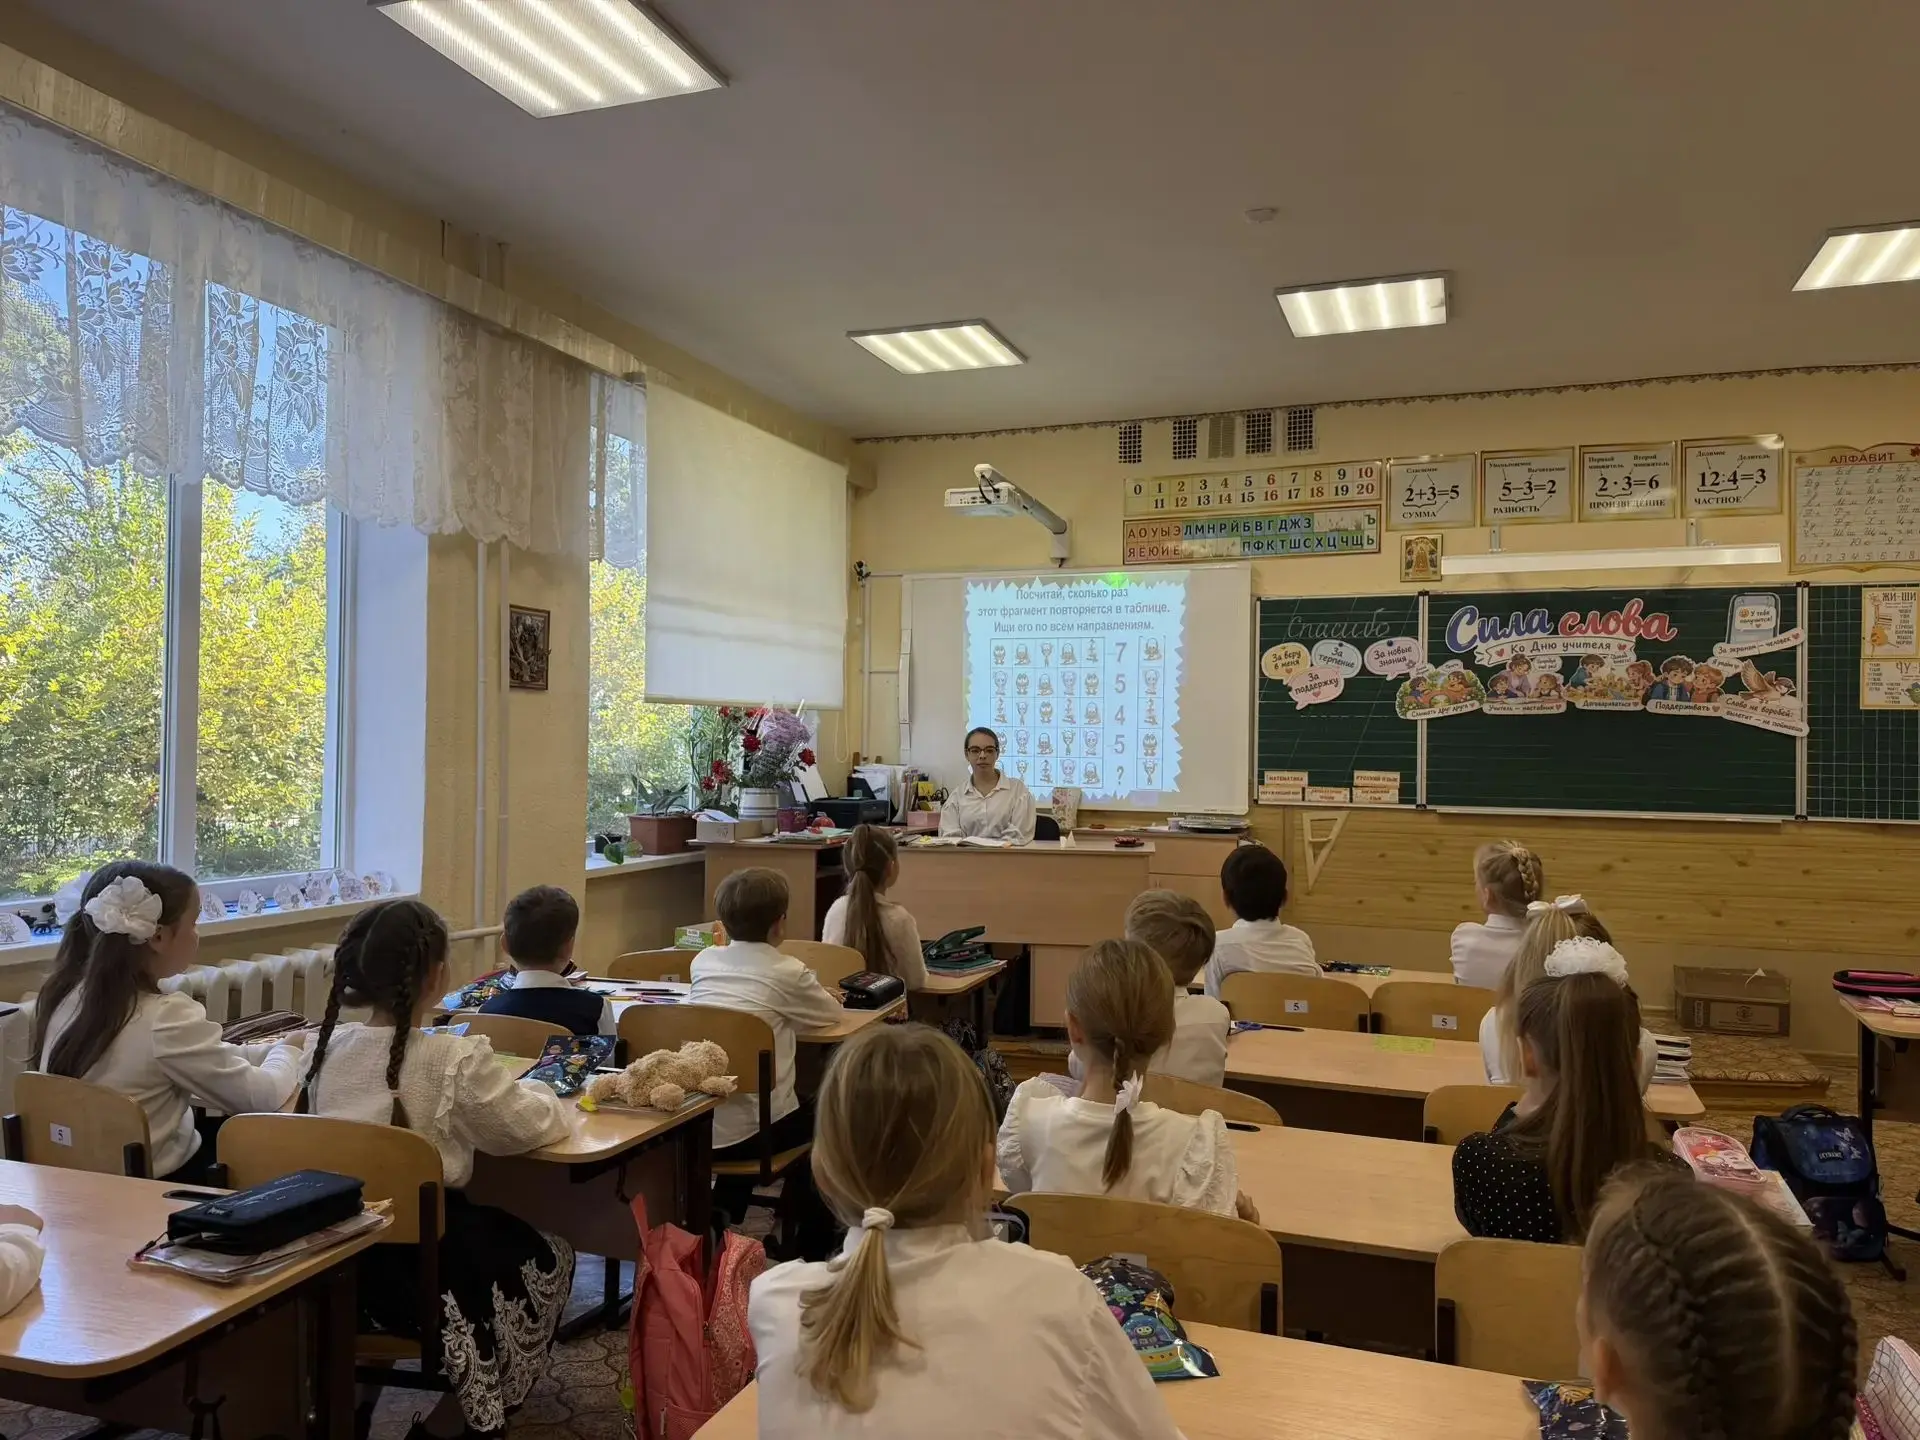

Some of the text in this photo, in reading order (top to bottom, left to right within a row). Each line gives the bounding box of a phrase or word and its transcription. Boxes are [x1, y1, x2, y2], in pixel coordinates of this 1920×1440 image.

[1829, 452, 1896, 464] АЛФАВИТ
[1133, 467, 1374, 495] 0 1 2 3 4 5 6 7 8 9 10
[1700, 468, 1767, 487] 12:4=3
[1153, 482, 1375, 509] 11 12 13 14 15 16 17 18 19 20
[1405, 484, 1460, 502] 2+3=5
[1694, 496, 1742, 505] ЧАСТНОЕ
[1402, 511, 1437, 519] СУММА
[1493, 505, 1540, 514] РАЗНОСТЬ
[1067, 589, 1108, 599] сколько
[1111, 588, 1128, 600] раз
[977, 602, 1170, 618] этот фрагмент повторяется в таблице.
[994, 621, 1154, 633] Ищи его по всем направлениям.
[1288, 608, 1390, 639] Спасибо
[1448, 599, 1677, 652] Сила слова
[1331, 647, 1343, 657] За
[1373, 645, 1412, 660] За новые
[1511, 641, 1611, 654] Ко Дню учителя
[1272, 651, 1301, 663] За веру
[1318, 654, 1355, 669] терпение
[1379, 655, 1407, 668] знания
[1281, 660, 1300, 668] меня
[1308, 673, 1320, 682] За
[1294, 678, 1339, 695] поддержку
[1655, 701, 1711, 712] Поддерживать
[1726, 697, 1747, 709] Слово
[1750, 704, 1758, 712] не
[1116, 766, 1125, 785] ?
[1293, 1003, 1300, 1011] 5
[1441, 1017, 1448, 1026] 5
[58, 1129, 64, 1141] 5
